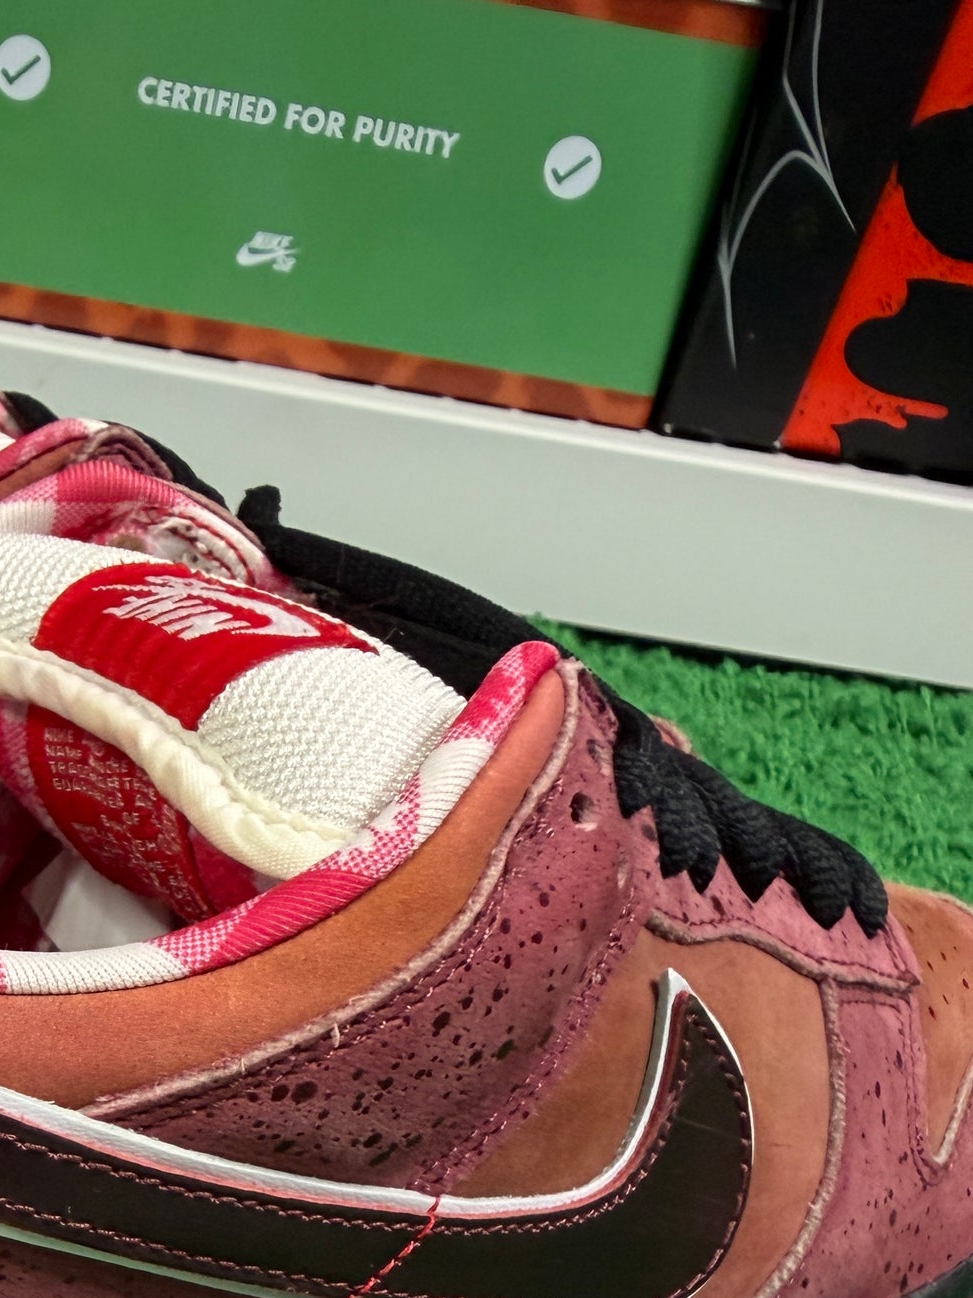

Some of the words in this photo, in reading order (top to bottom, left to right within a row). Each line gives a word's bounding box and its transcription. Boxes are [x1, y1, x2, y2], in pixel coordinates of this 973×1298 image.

[137, 76, 277, 125] CERTIFIED
[284, 103, 346, 139] FOR
[352, 115, 460, 159] PURITY
